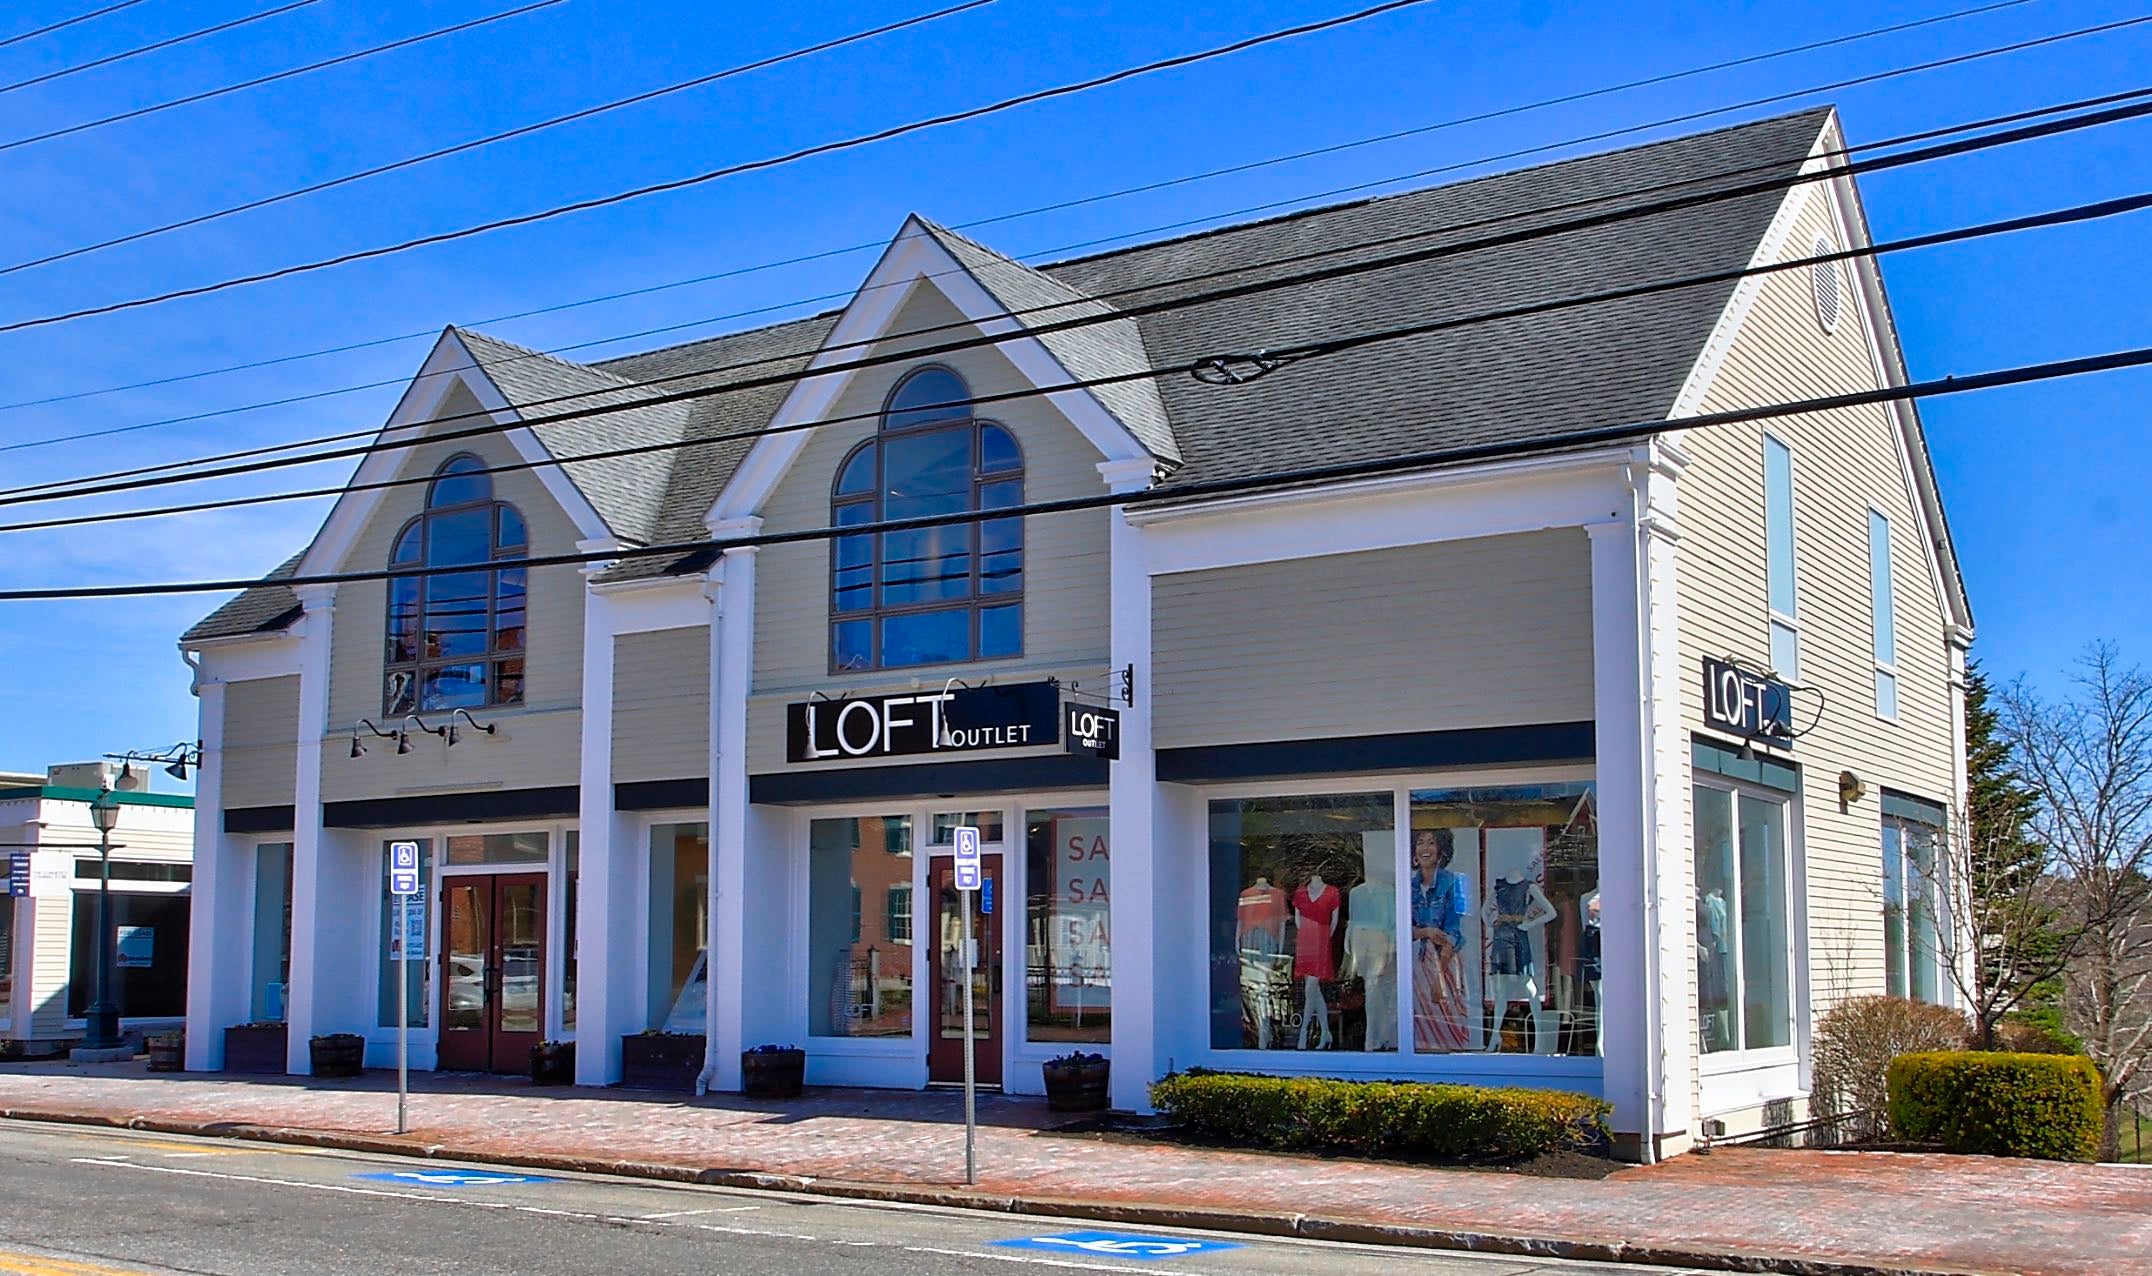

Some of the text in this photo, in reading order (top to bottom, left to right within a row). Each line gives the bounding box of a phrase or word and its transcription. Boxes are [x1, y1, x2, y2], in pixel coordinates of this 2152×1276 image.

[1710, 664, 1767, 731] LOFT
[810, 693, 1031, 757] LOFT OUTLET
[1071, 710, 1115, 740] LOFT
[1082, 738, 1106, 748] OUTLET
[1068, 835, 1110, 862] SA
[1068, 877, 1110, 904] SA
